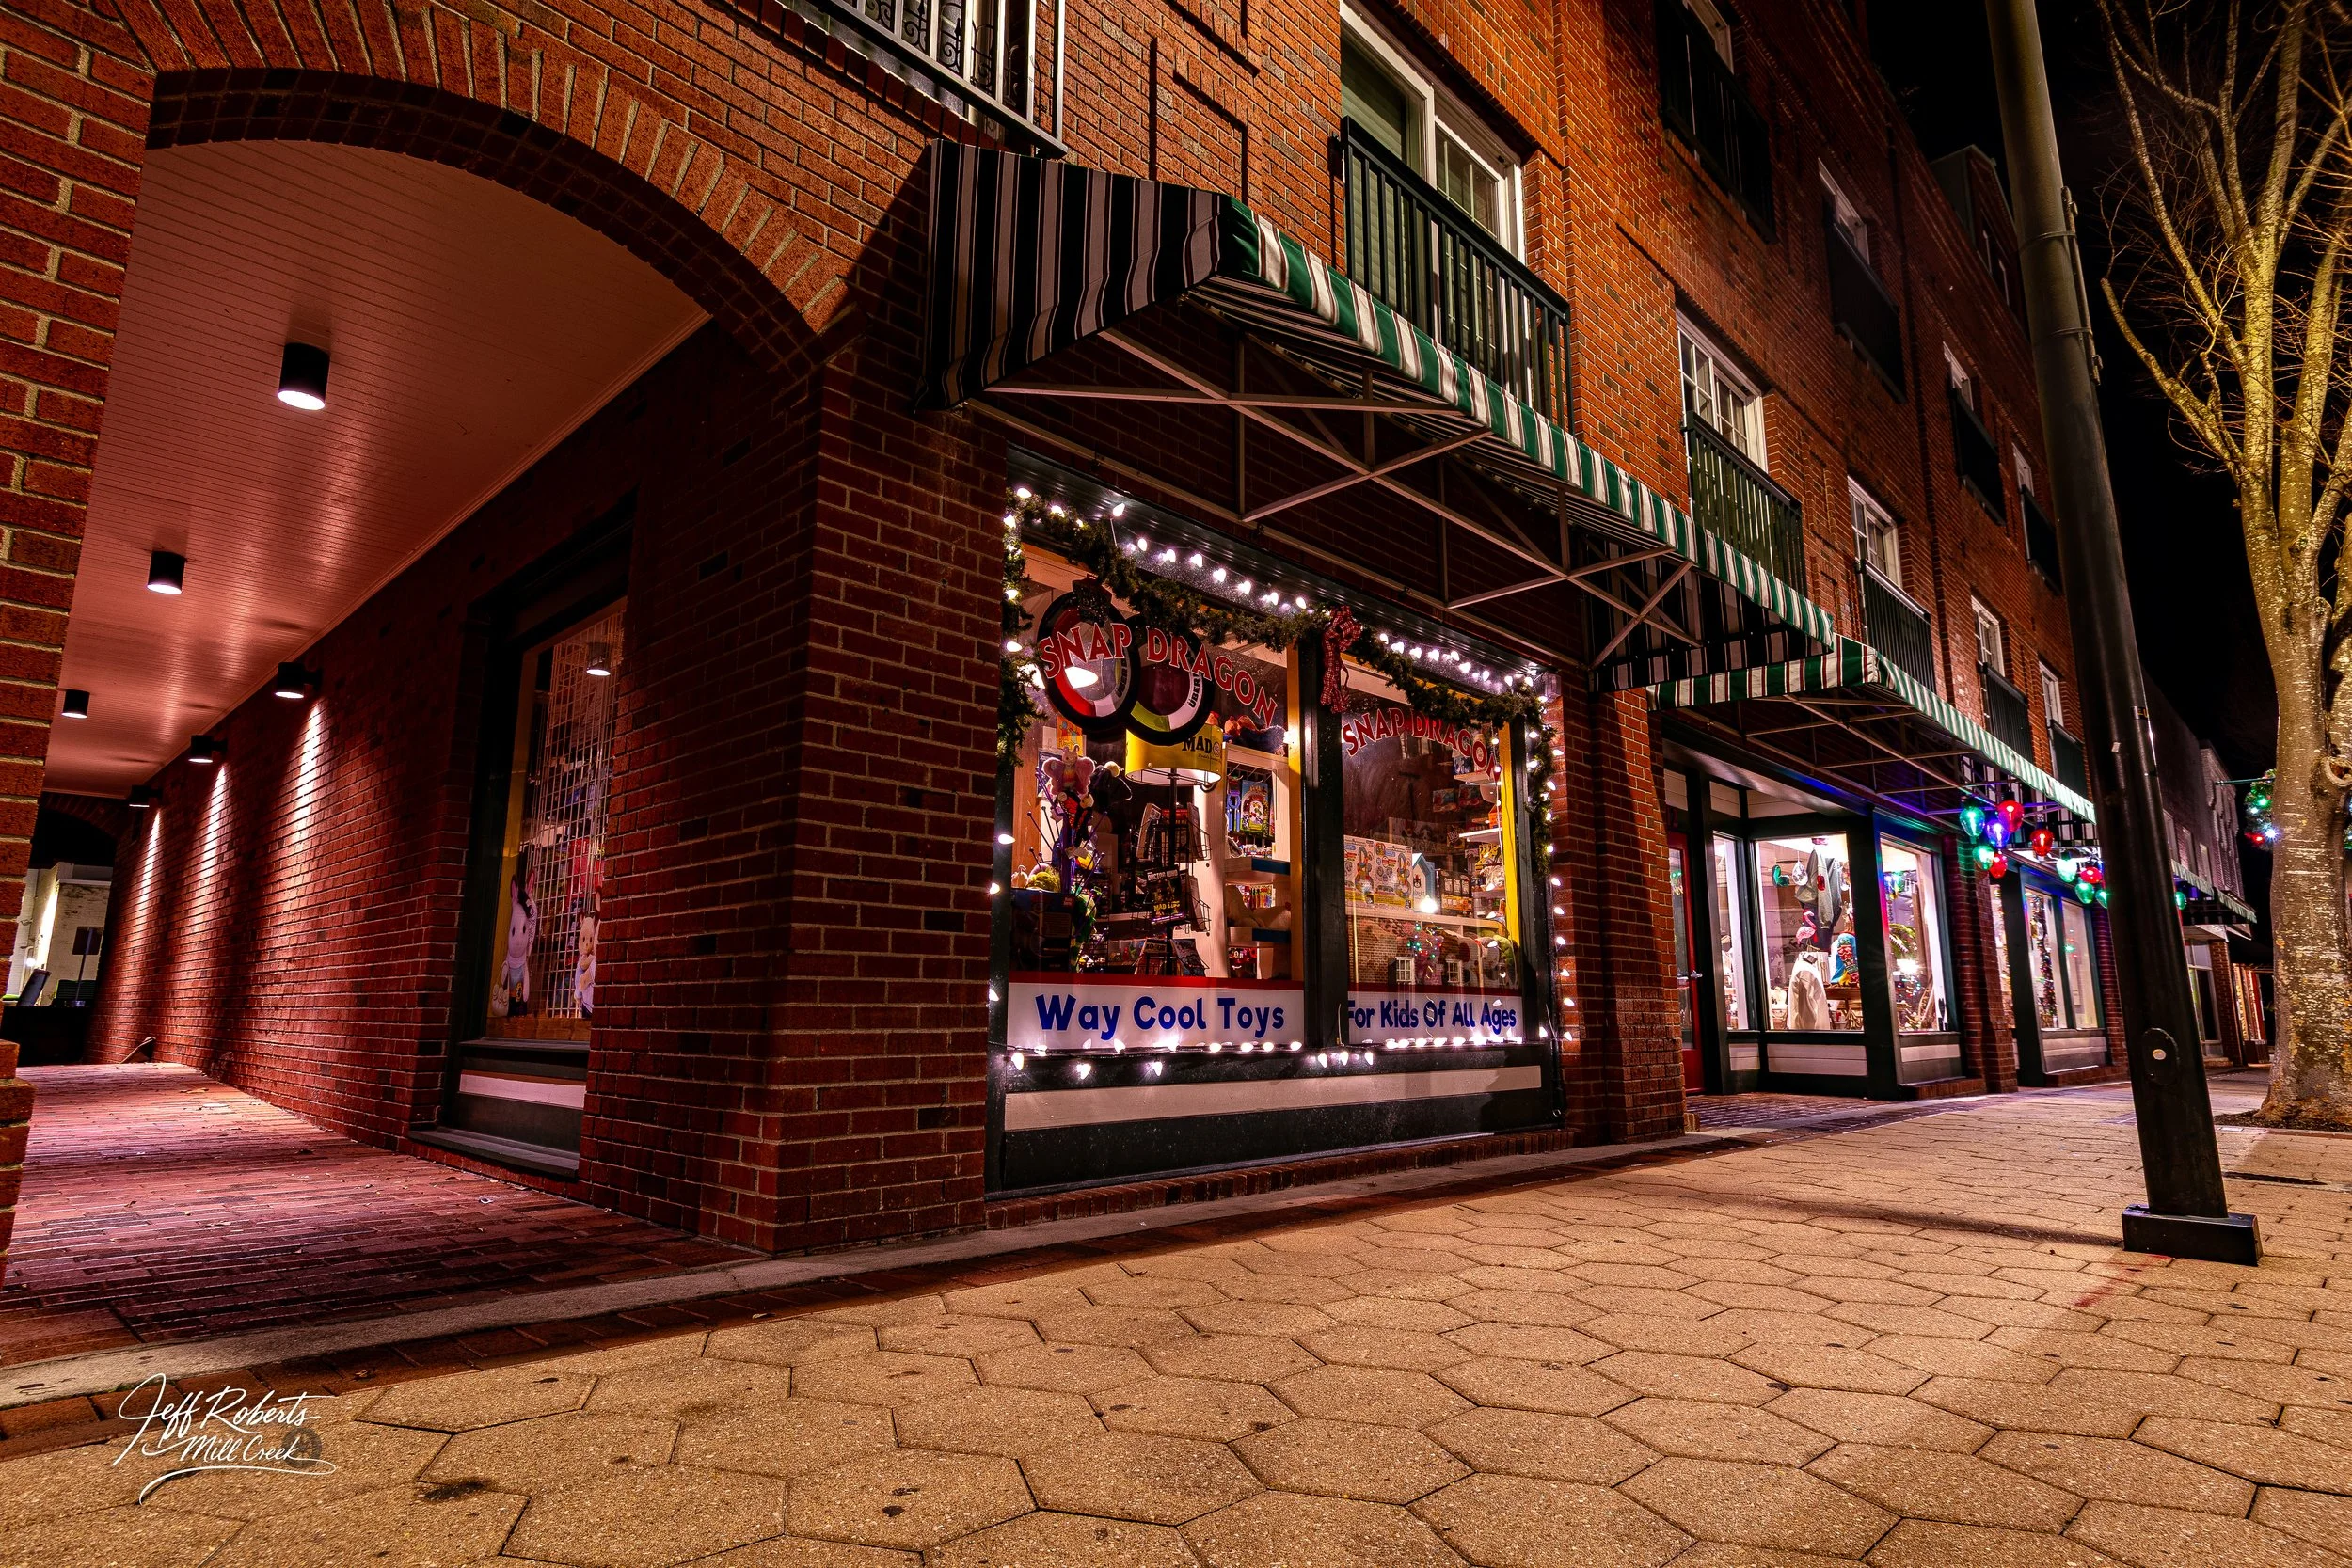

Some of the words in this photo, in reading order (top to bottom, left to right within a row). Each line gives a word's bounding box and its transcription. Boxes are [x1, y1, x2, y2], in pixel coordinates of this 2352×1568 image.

[1039, 623, 1132, 679] SNAP
[1146, 626, 1278, 729] DRAGON
[1342, 707, 1405, 756] SNAP
[1035, 993, 1120, 1041] Way
[1133, 995, 1207, 1031] Cool
[1217, 997, 1285, 1038] Toys
[1347, 1000, 1375, 1029] For
[1380, 999, 1419, 1029] Kids
[1423, 999, 1446, 1028] Of
[1452, 1001, 1476, 1028] All
[1480, 1002, 1517, 1036] Ages
